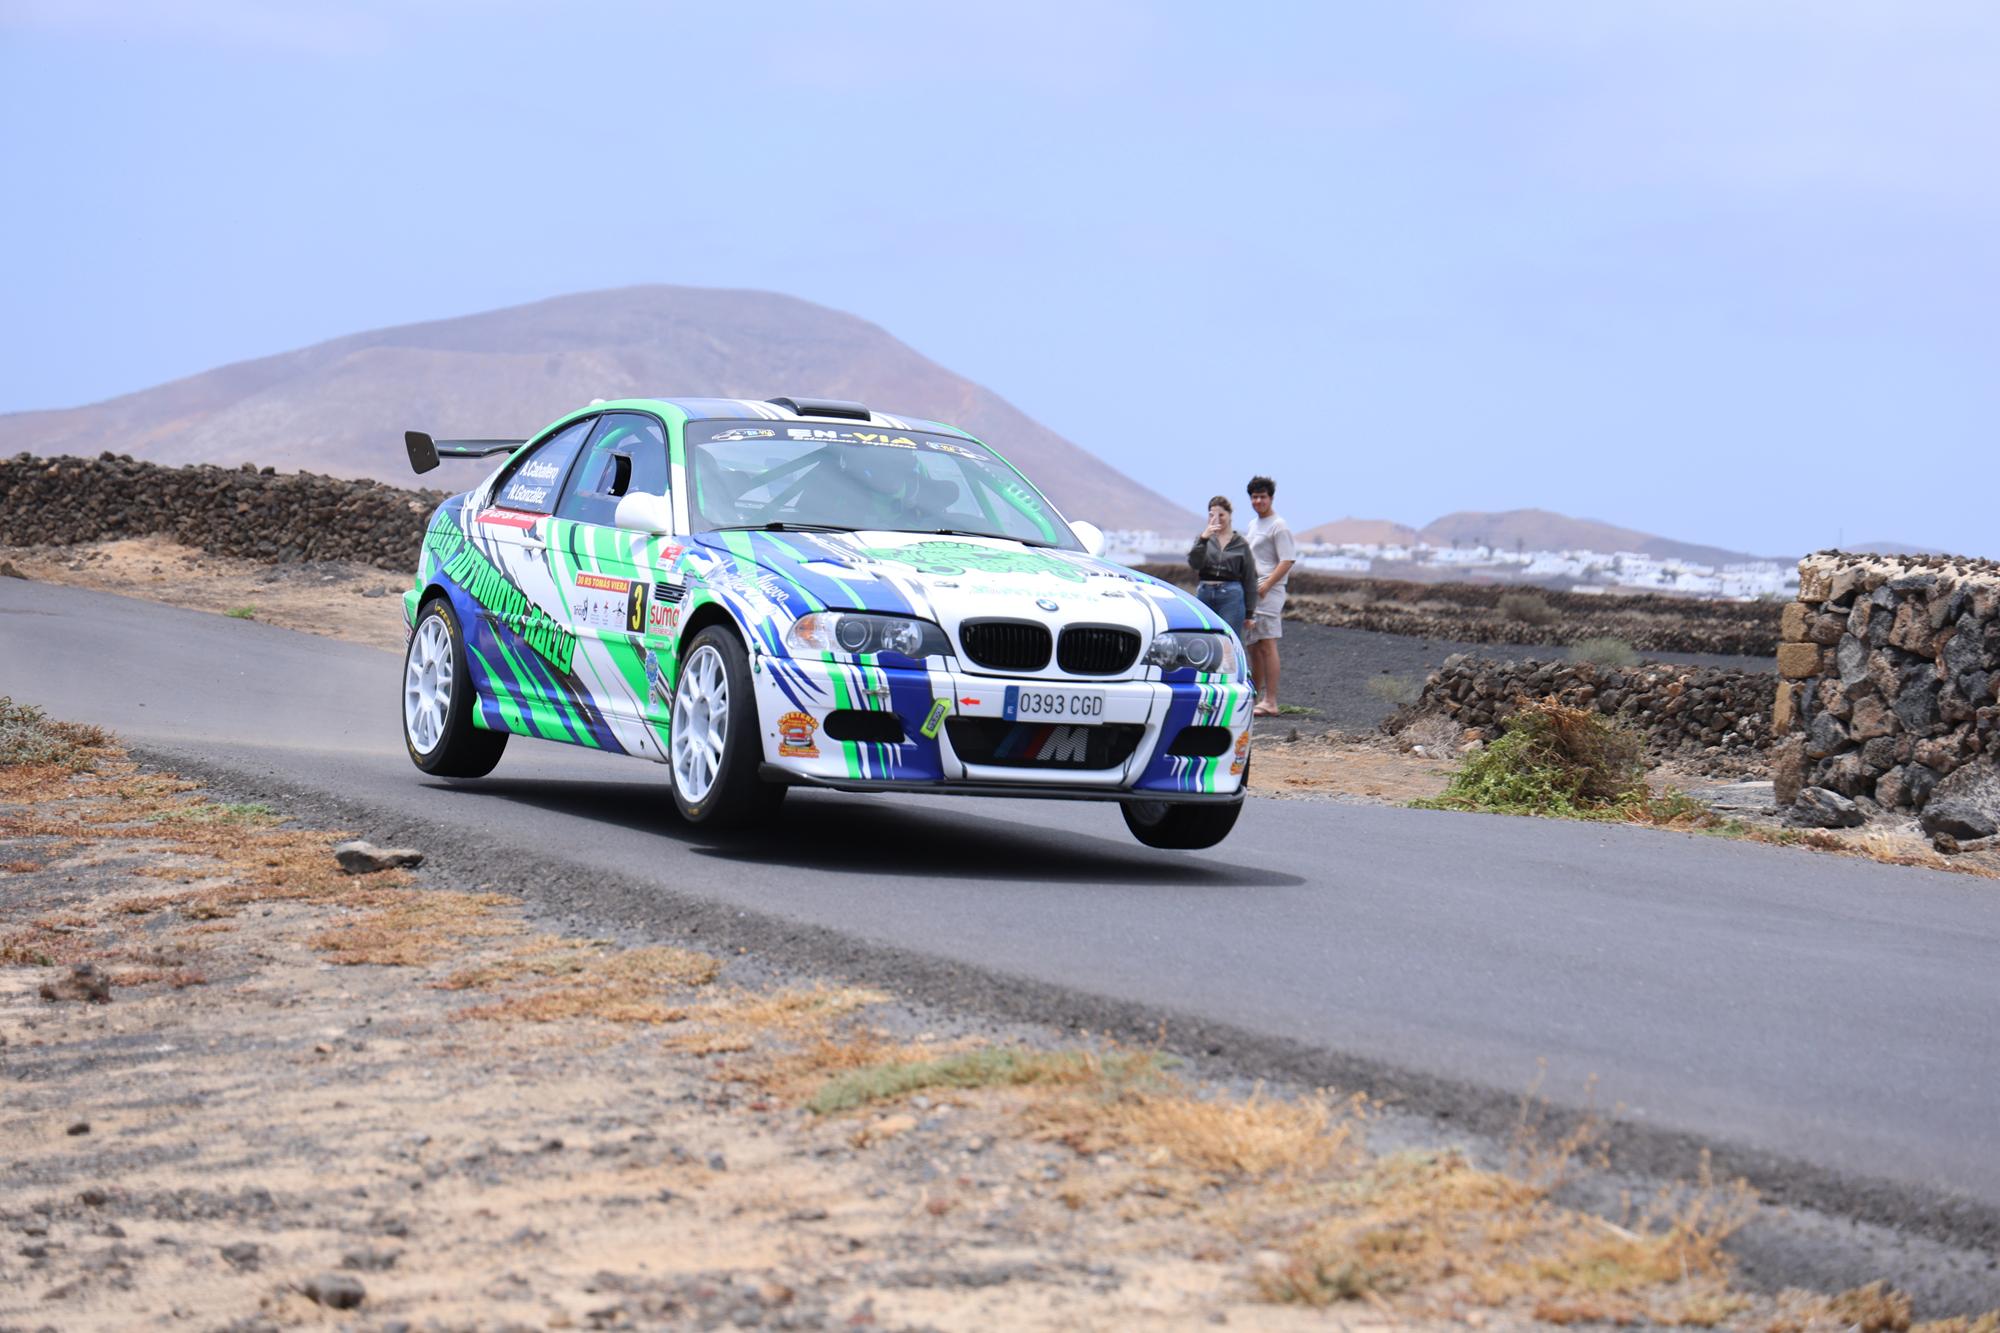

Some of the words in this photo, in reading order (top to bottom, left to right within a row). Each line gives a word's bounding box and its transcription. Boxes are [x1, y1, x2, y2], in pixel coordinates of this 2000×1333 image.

[787, 429, 917, 447] EN-VIA
[632, 584, 643, 630] 3
[1007, 706, 1014, 714] E
[1020, 693, 1065, 714] 0393
[1070, 696, 1103, 716] CGD
[1036, 726, 1089, 762] M
